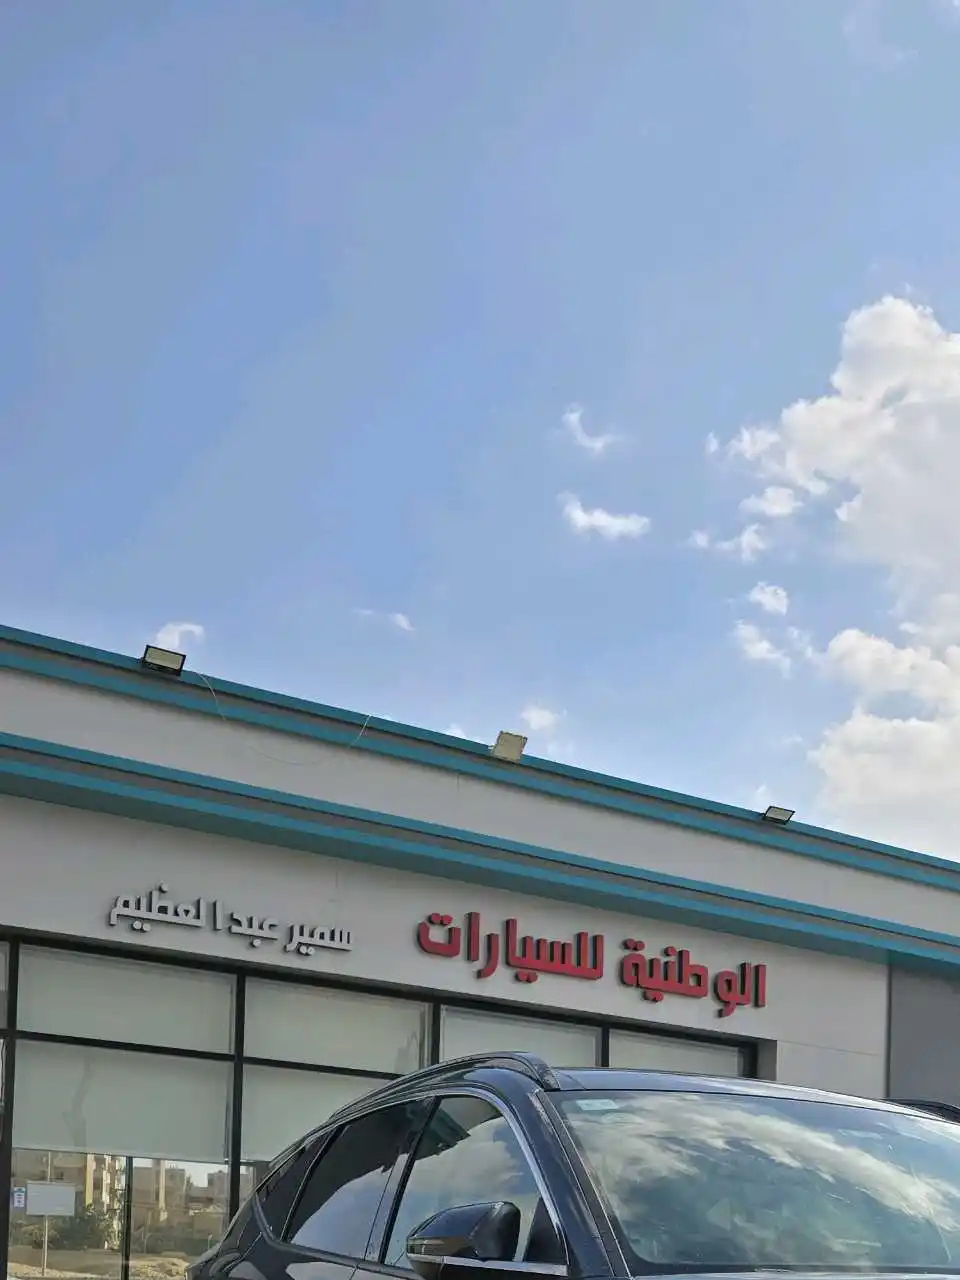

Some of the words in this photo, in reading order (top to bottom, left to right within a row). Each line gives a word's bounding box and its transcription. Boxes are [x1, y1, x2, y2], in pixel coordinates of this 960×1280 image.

[229, 911, 279, 948] عبد
[285, 921, 353, 956] سمير
[417, 912, 604, 984] للسيارات
[620, 938, 767, 1018] الوطنية
